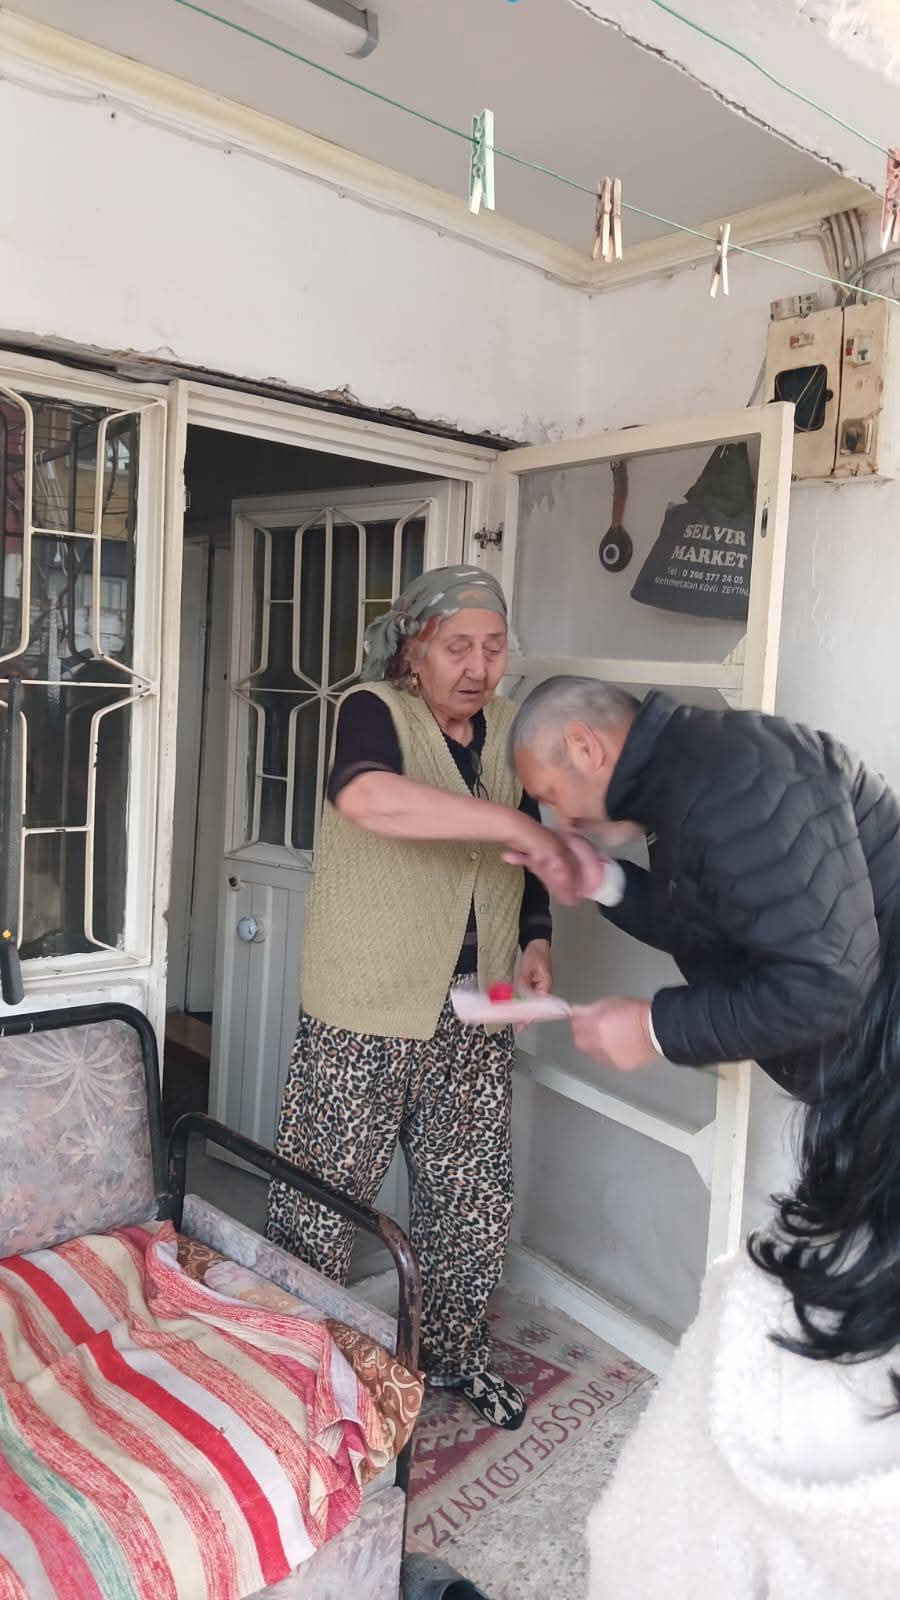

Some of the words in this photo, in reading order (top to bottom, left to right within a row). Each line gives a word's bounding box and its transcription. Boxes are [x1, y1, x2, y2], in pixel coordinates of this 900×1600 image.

[683, 524, 746, 546] SELVER
[671, 545, 748, 568] MARKET
[704, 573, 721, 583] 377
[733, 576, 744, 585] 05
